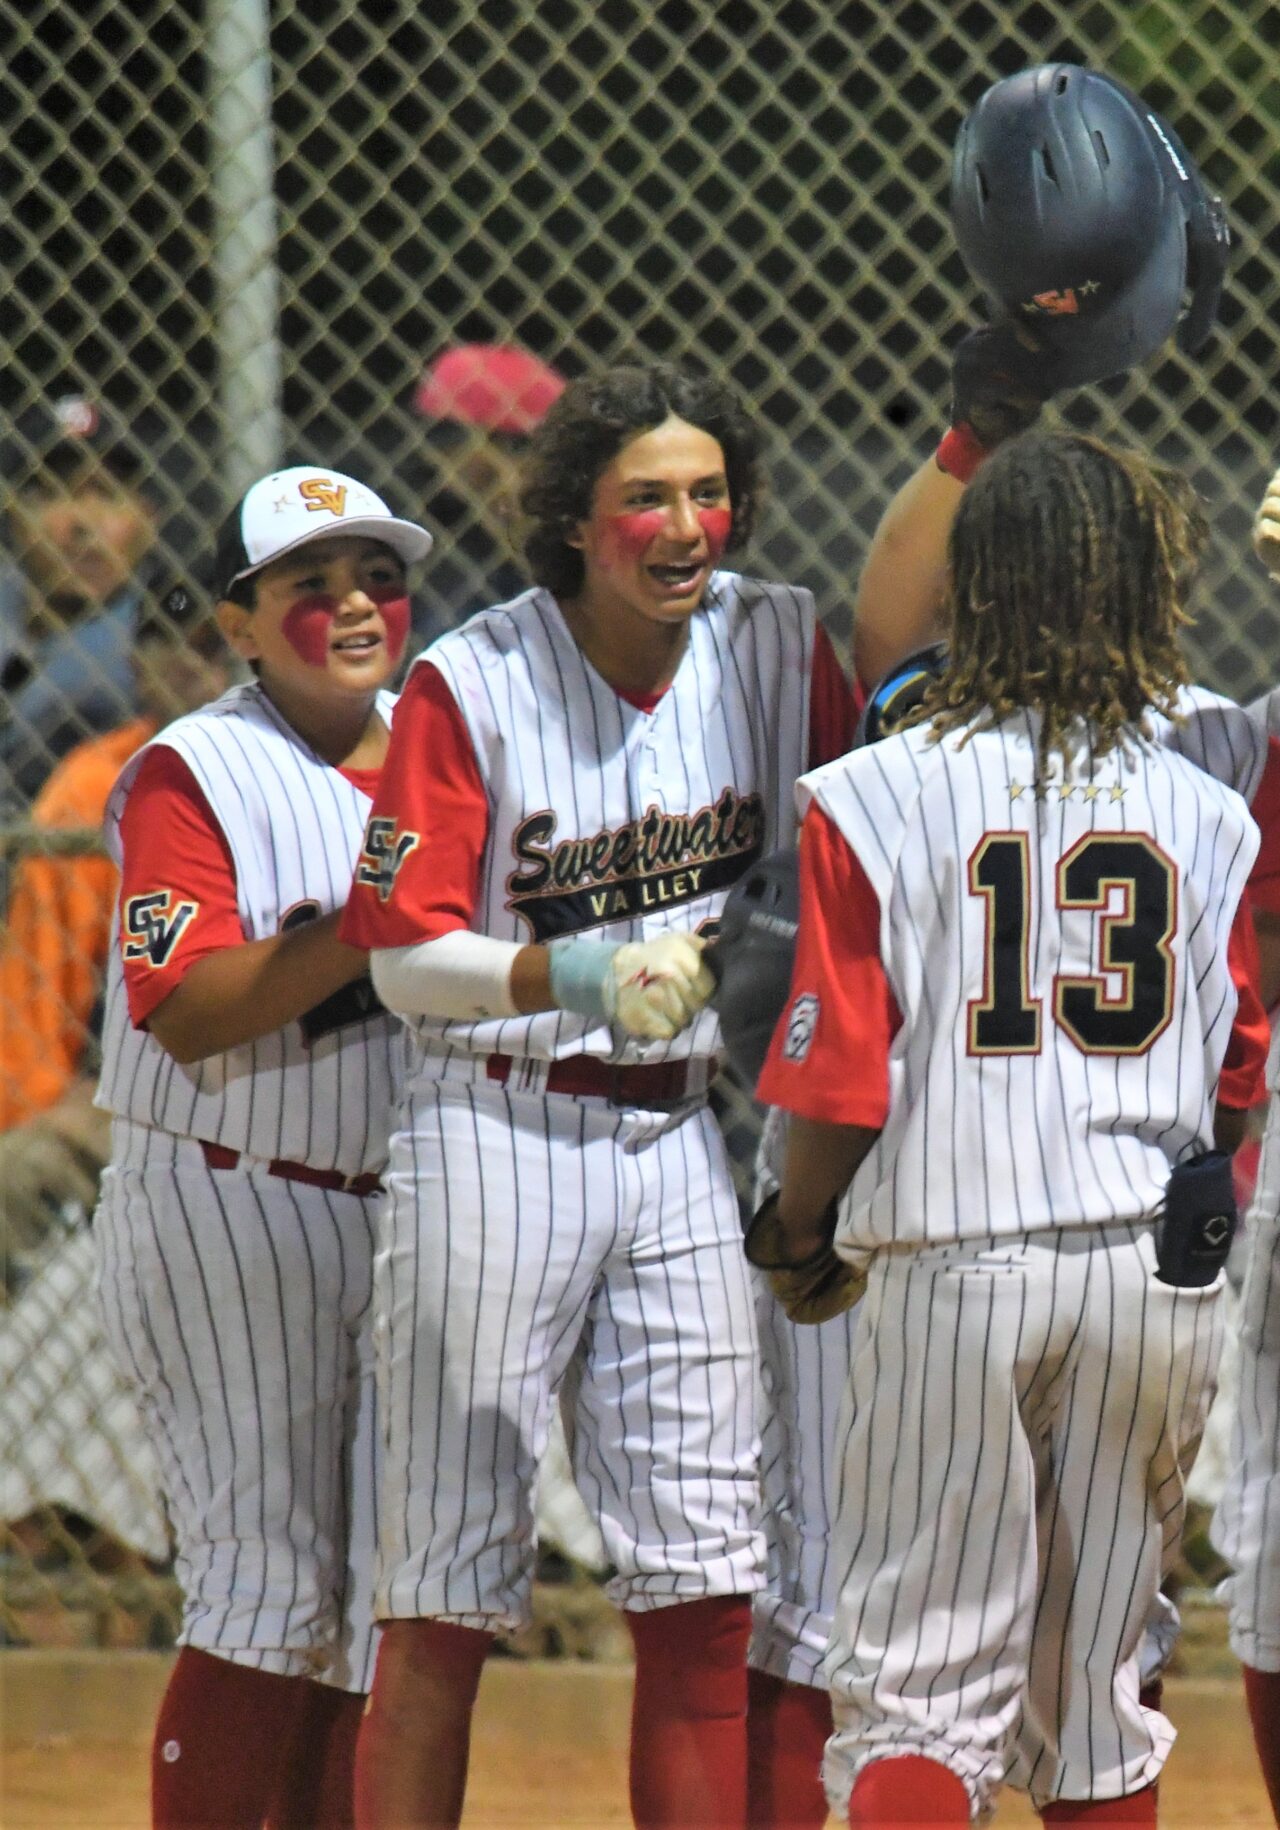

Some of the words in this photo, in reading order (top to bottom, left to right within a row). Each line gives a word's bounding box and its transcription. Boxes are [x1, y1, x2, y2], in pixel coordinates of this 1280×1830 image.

[298, 478, 348, 516] SV
[357, 816, 421, 902] SV
[590, 868, 701, 917] VALLEY
[123, 889, 199, 968] SV
[966, 831, 1179, 1057] 13
